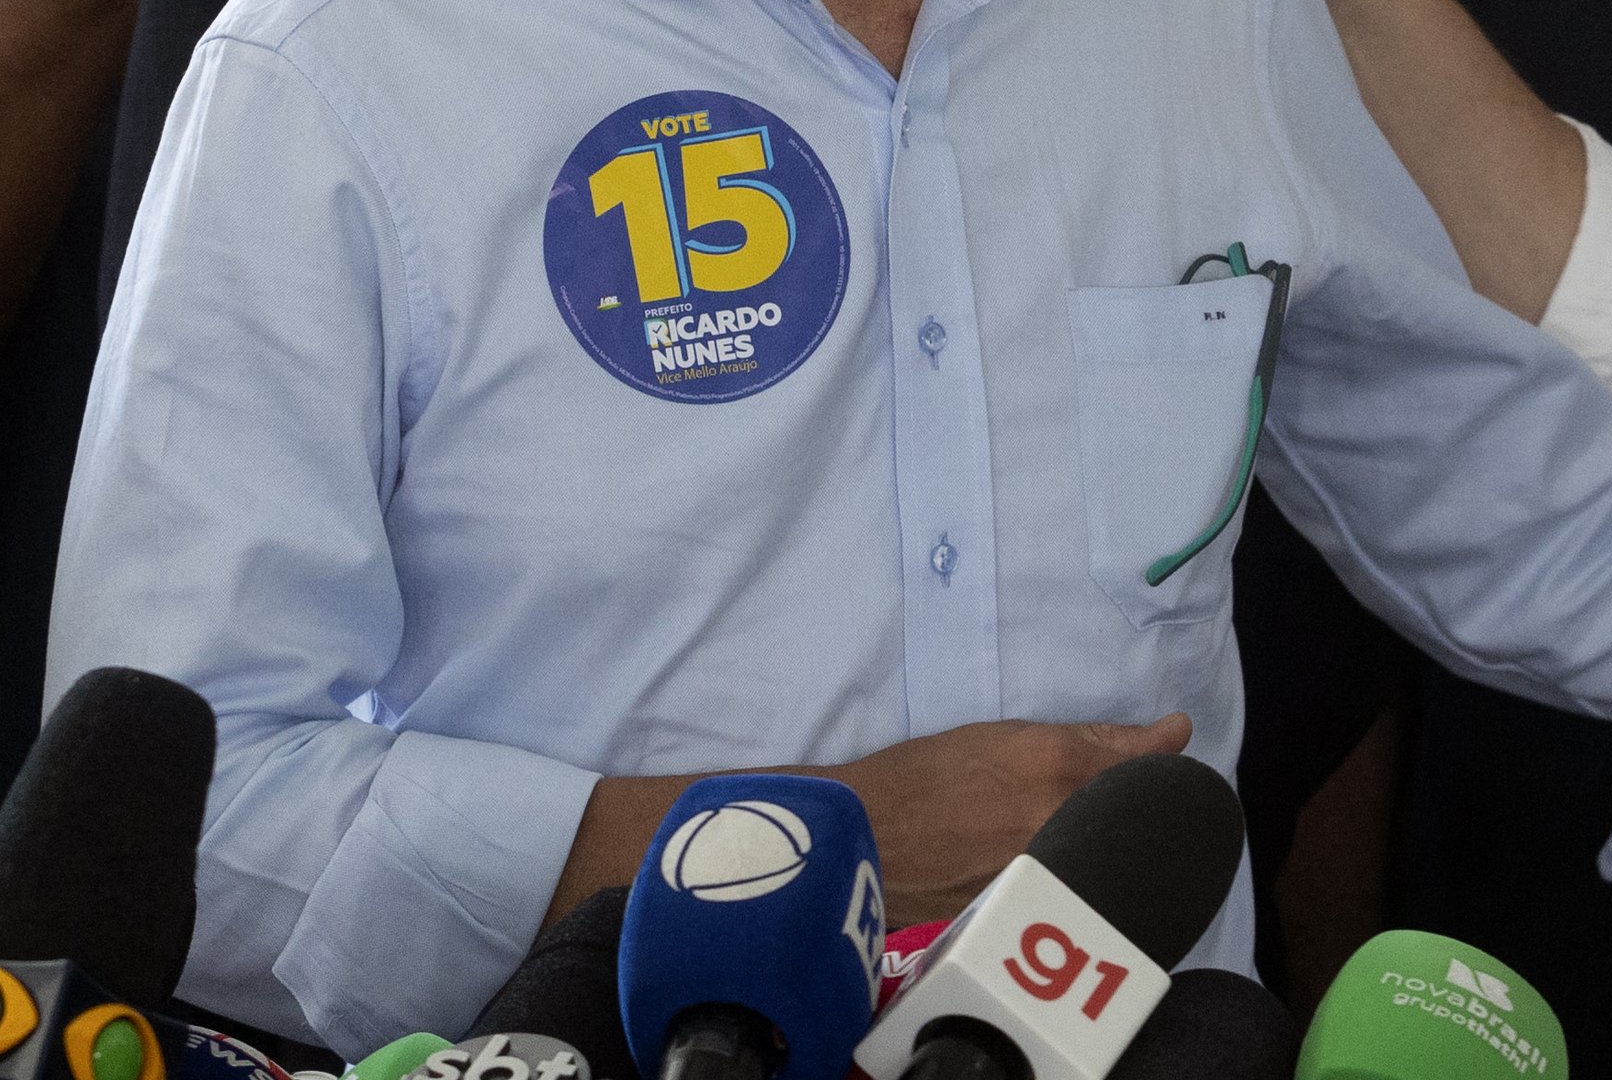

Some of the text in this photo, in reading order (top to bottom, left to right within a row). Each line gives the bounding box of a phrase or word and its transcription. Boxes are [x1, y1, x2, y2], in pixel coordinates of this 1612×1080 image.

[641, 110, 710, 139] VOTE
[588, 126, 795, 303] 15
[644, 302, 693, 318] PREFEITO
[645, 302, 782, 348] RICARDO
[651, 335, 754, 372] NUNES
[656, 373, 682, 385] Vice
[684, 366, 717, 380] Mello
[719, 359, 758, 375] Araújo
[1003, 922, 1129, 1022] g1
[1381, 971, 1548, 1074] novabrasil
[402, 1034, 579, 1080] sbt
